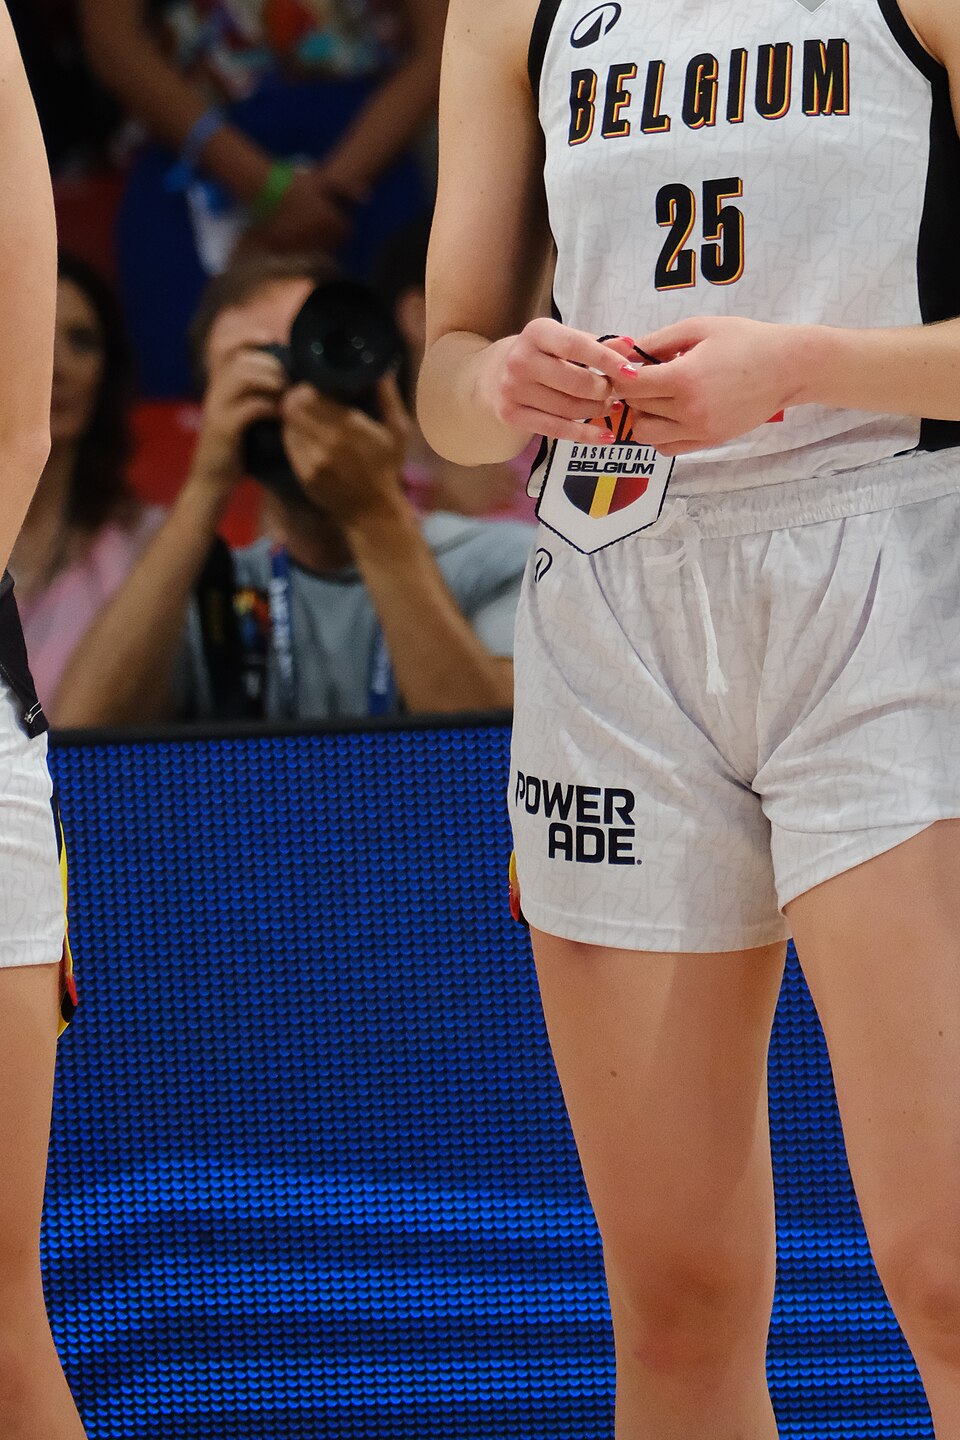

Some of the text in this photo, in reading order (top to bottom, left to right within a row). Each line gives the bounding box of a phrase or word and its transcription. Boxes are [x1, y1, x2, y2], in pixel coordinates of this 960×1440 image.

[568, 38, 850, 146] BELGIUM
[654, 176, 744, 291] 25
[567, 460, 655, 474] BELGIUM
[571, 445, 657, 461] BASKETBALL
[515, 770, 636, 825] POWER
